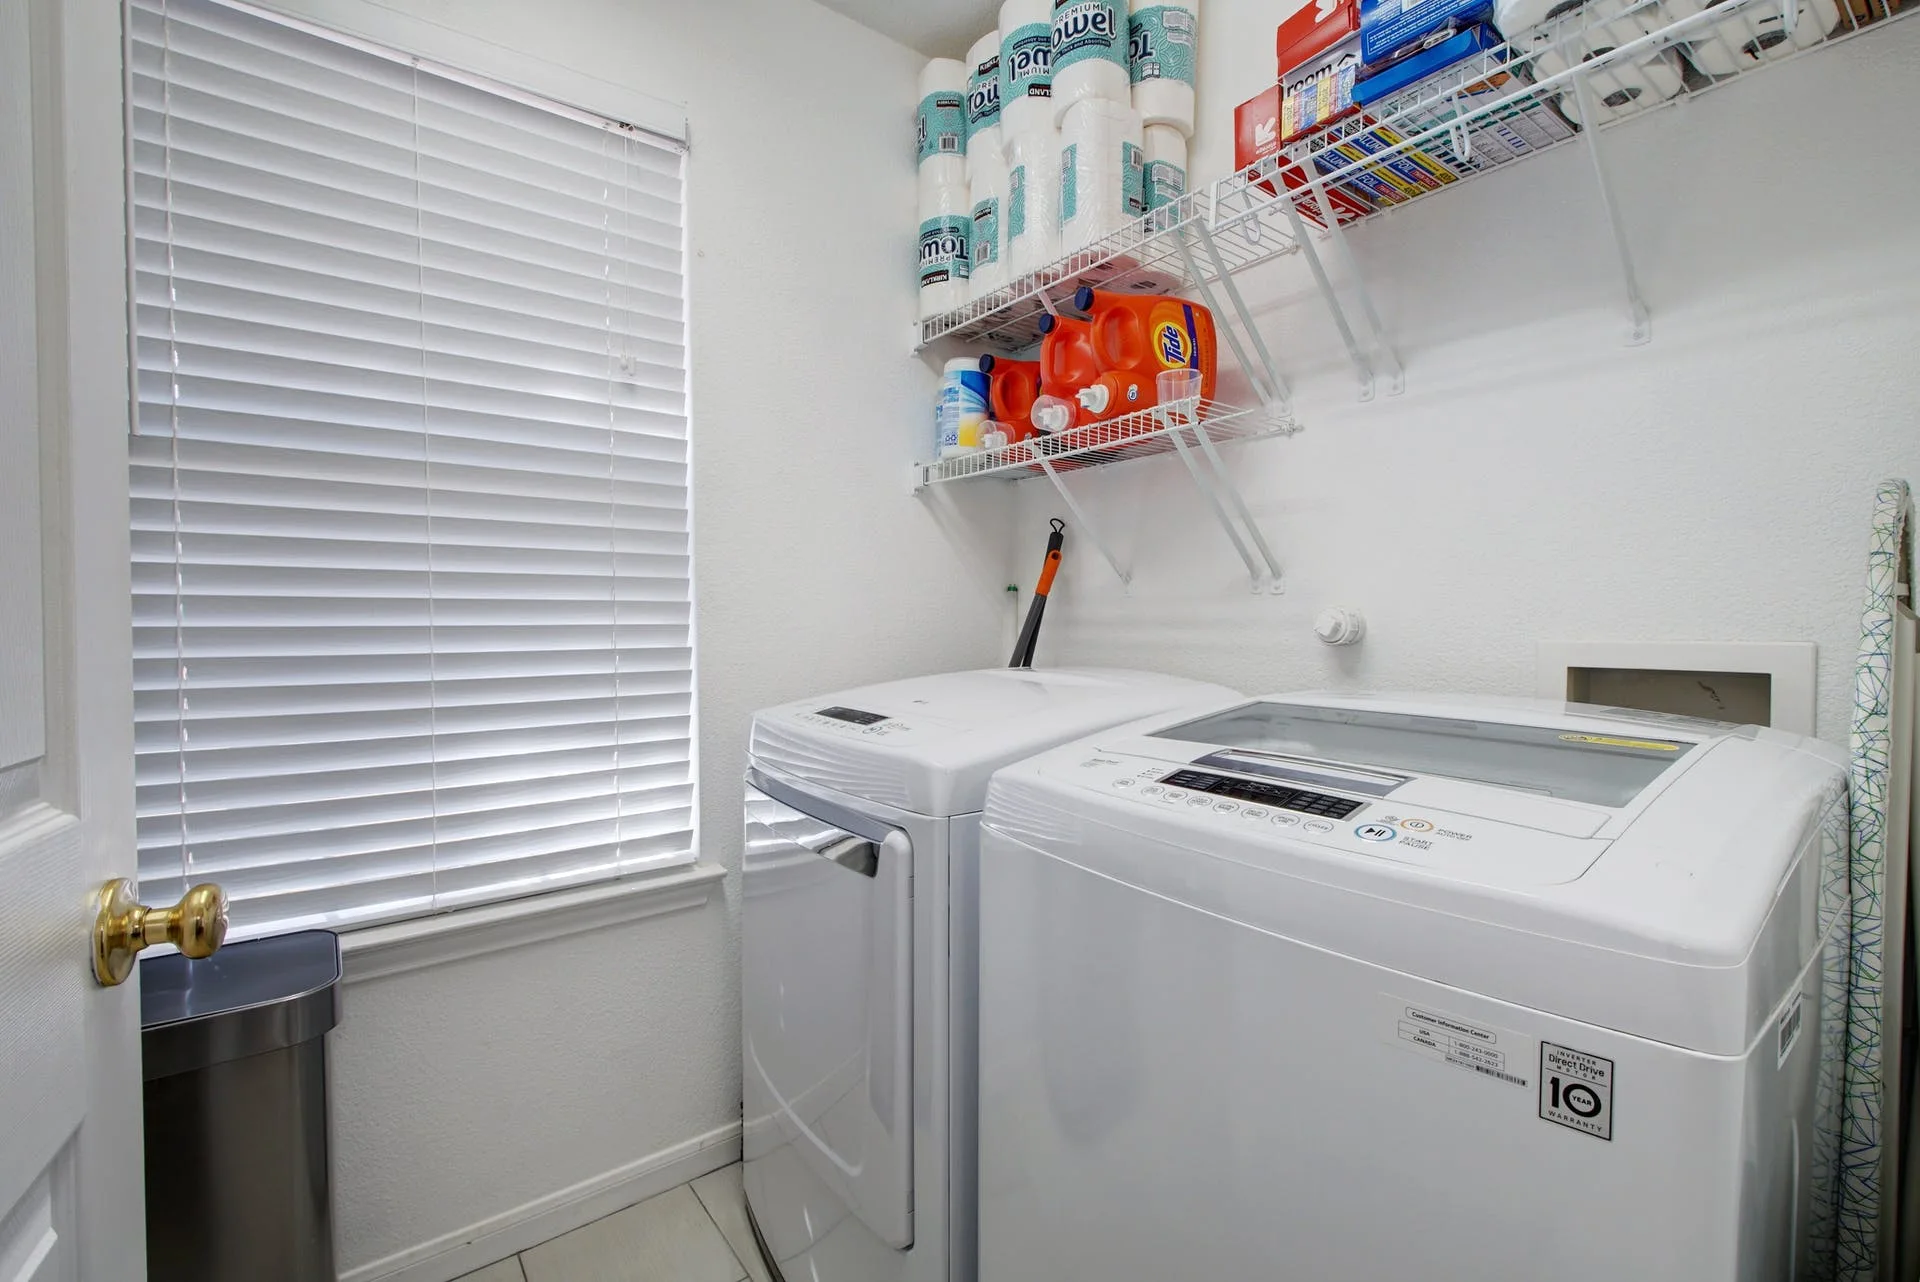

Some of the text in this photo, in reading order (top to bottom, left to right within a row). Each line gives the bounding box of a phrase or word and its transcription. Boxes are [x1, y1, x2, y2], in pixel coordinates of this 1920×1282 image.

[1055, 3, 1101, 25] PREMIUM
[1052, 8, 1115, 49] owel
[1009, 47, 1051, 81] wel
[1022, 67, 1050, 77] MIUM
[977, 77, 998, 89] PREM
[1287, 64, 1332, 97] room
[968, 83, 999, 114] Tow
[920, 239, 968, 263] Tow
[1163, 325, 1186, 363] Tide
[1403, 836, 1433, 846] START
[1412, 1011, 1490, 1040] Customer Information Center
[1419, 1029, 1430, 1037] USA
[1413, 1036, 1436, 1047] CANADA
[1548, 1054, 1605, 1077] Direct Drive
[1557, 1050, 1596, 1066] INVERTER
[1557, 1065, 1596, 1080] MOTOR
[1550, 1076, 1602, 1118] 10
[1572, 1095, 1592, 1106] YEAR
[1548, 1110, 1602, 1132] WARRANTY
